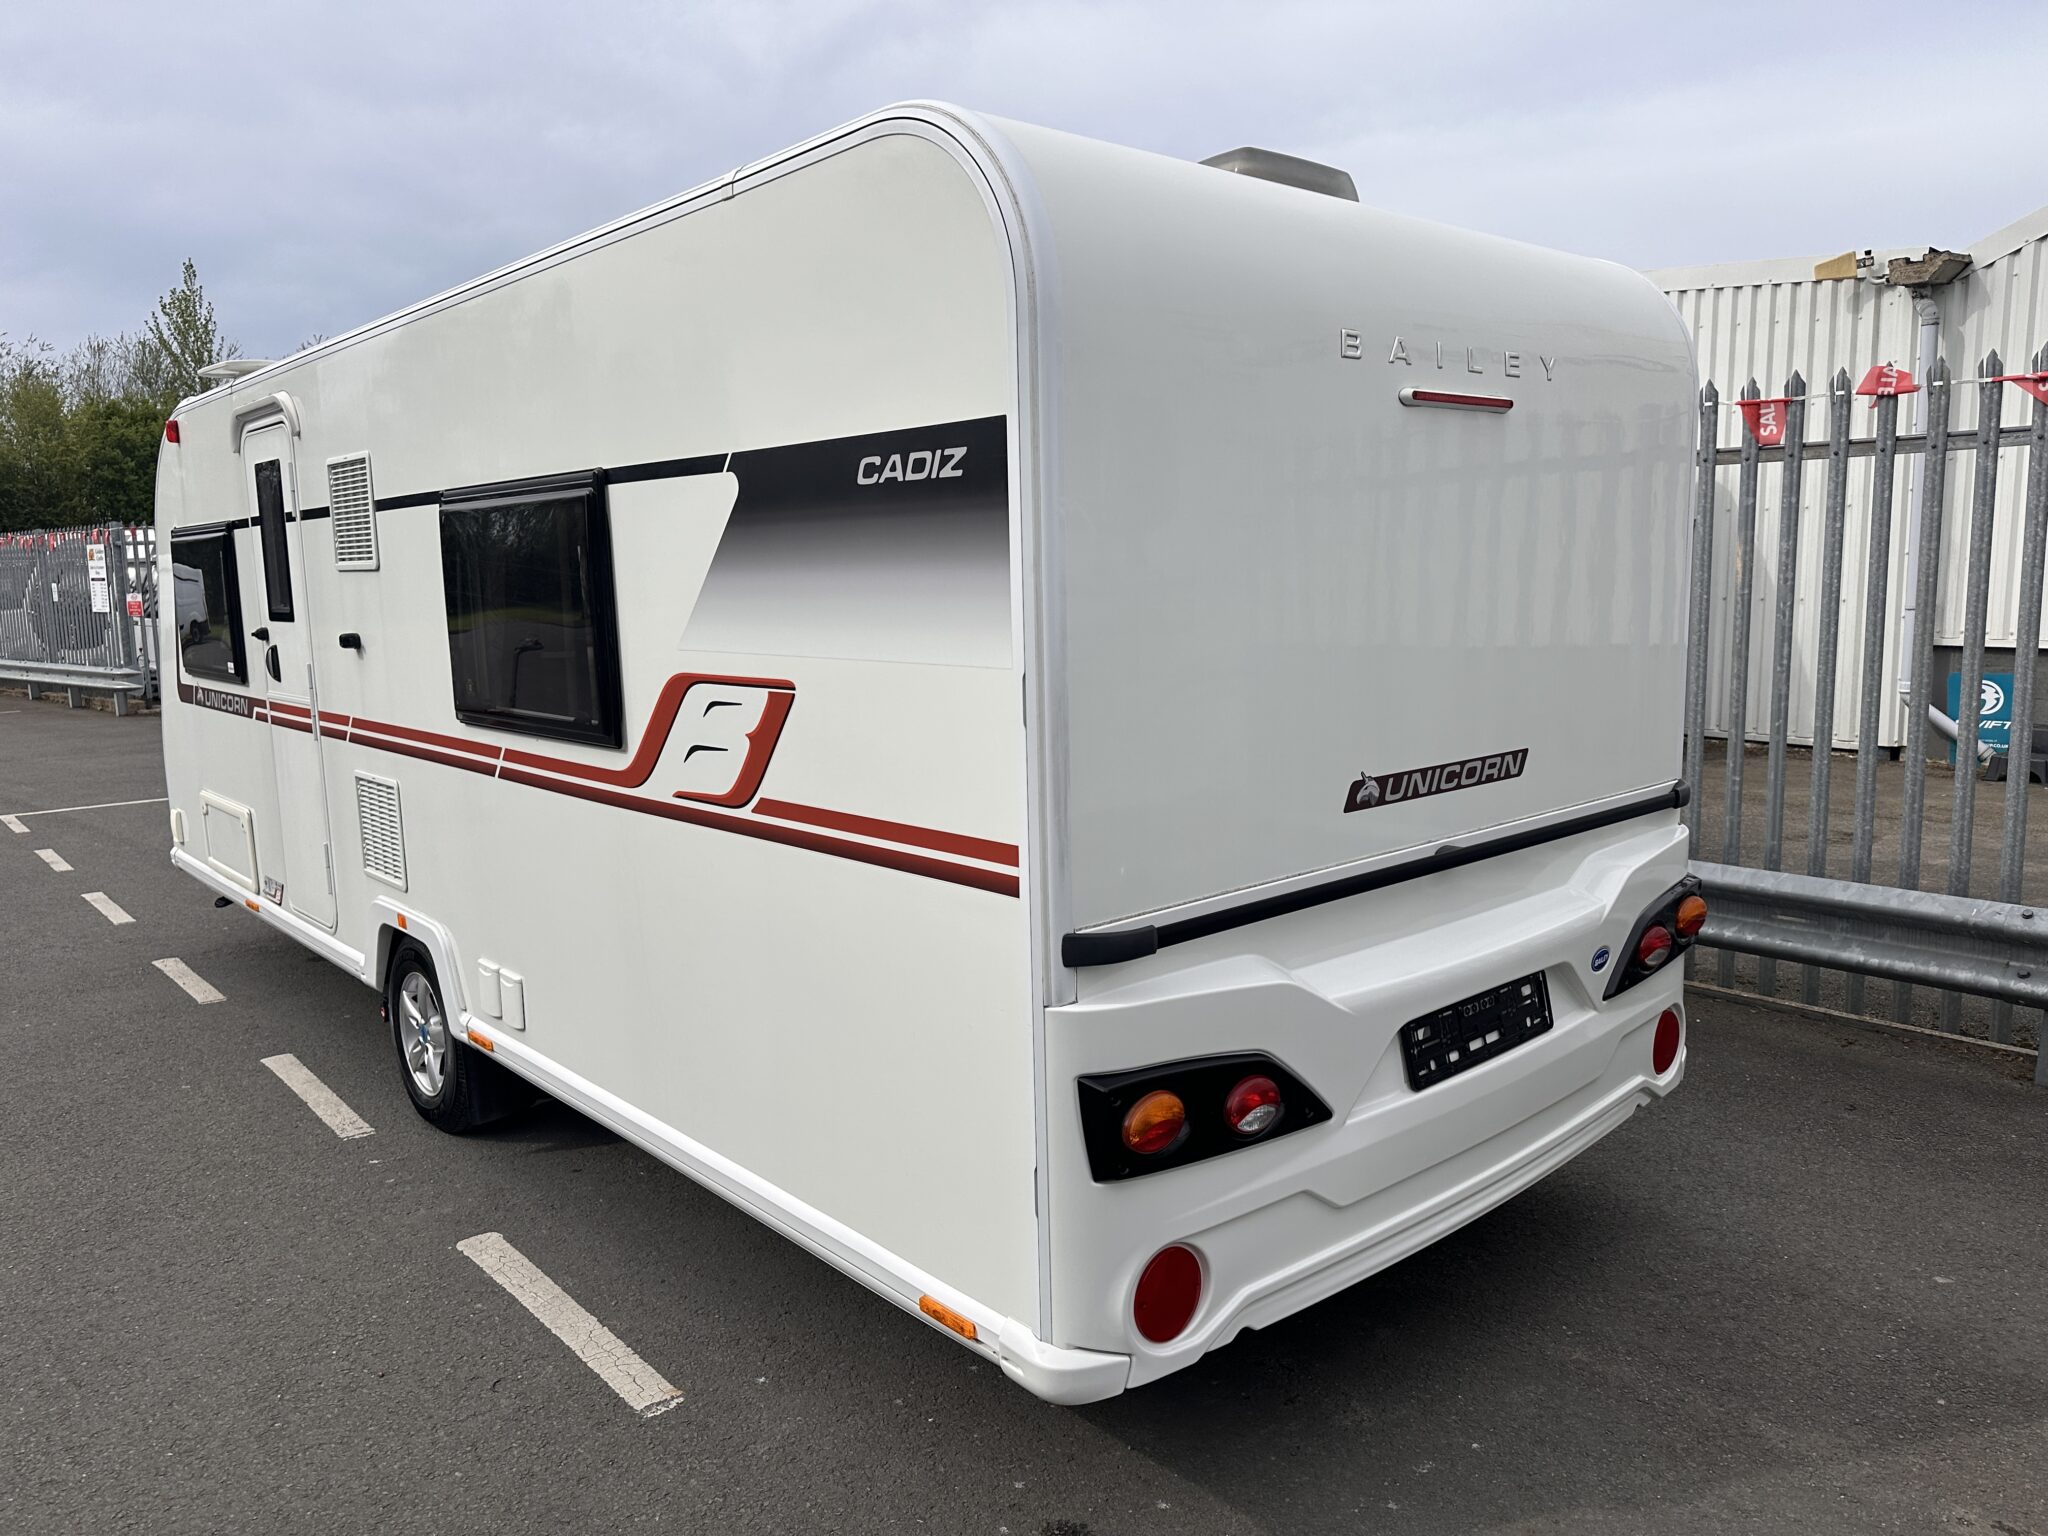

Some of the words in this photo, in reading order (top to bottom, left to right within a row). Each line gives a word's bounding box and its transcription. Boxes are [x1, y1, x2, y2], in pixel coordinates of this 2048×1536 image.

[1340, 328, 1556, 382] BAILEY
[1878, 366, 1898, 396] ALE
[1759, 402, 1777, 436] SAL
[857, 446, 968, 485] CADIZ
[204, 690, 248, 715] UNICORN
[1384, 752, 1523, 801] UNICORN
